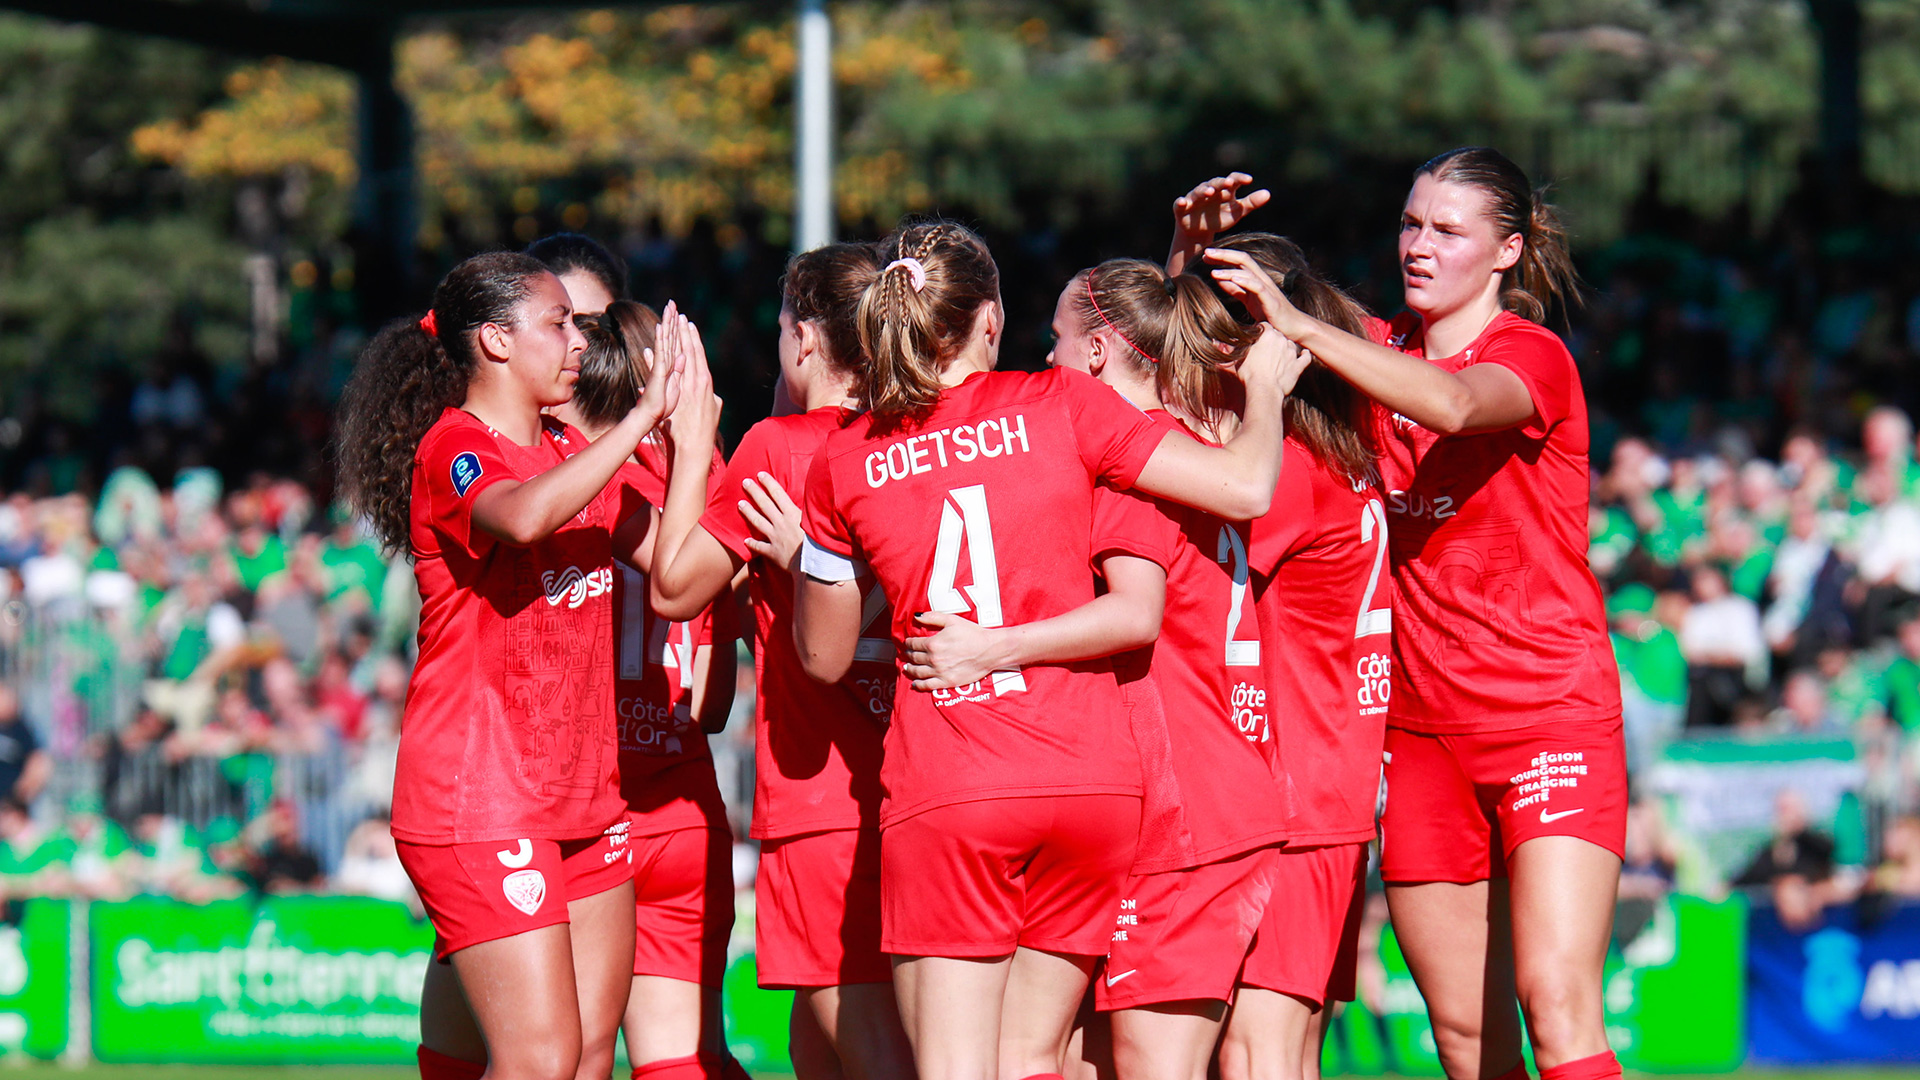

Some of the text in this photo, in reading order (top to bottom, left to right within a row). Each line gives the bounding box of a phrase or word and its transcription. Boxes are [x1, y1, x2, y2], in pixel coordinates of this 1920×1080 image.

[865, 414, 1030, 489] GOETSCH
[927, 484, 1004, 628] 4
[1354, 498, 1392, 639] 2
[1217, 523, 1260, 666] 2
[1357, 652, 1391, 679] Côt
[1231, 681, 1266, 707] Côte
[1357, 677, 1391, 705] d'O
[618, 697, 669, 724] Côte
[1531, 751, 1583, 767] RÉGION
[1518, 776, 1578, 795] FRANCHE
[1512, 788, 1550, 811] COMTÉ
